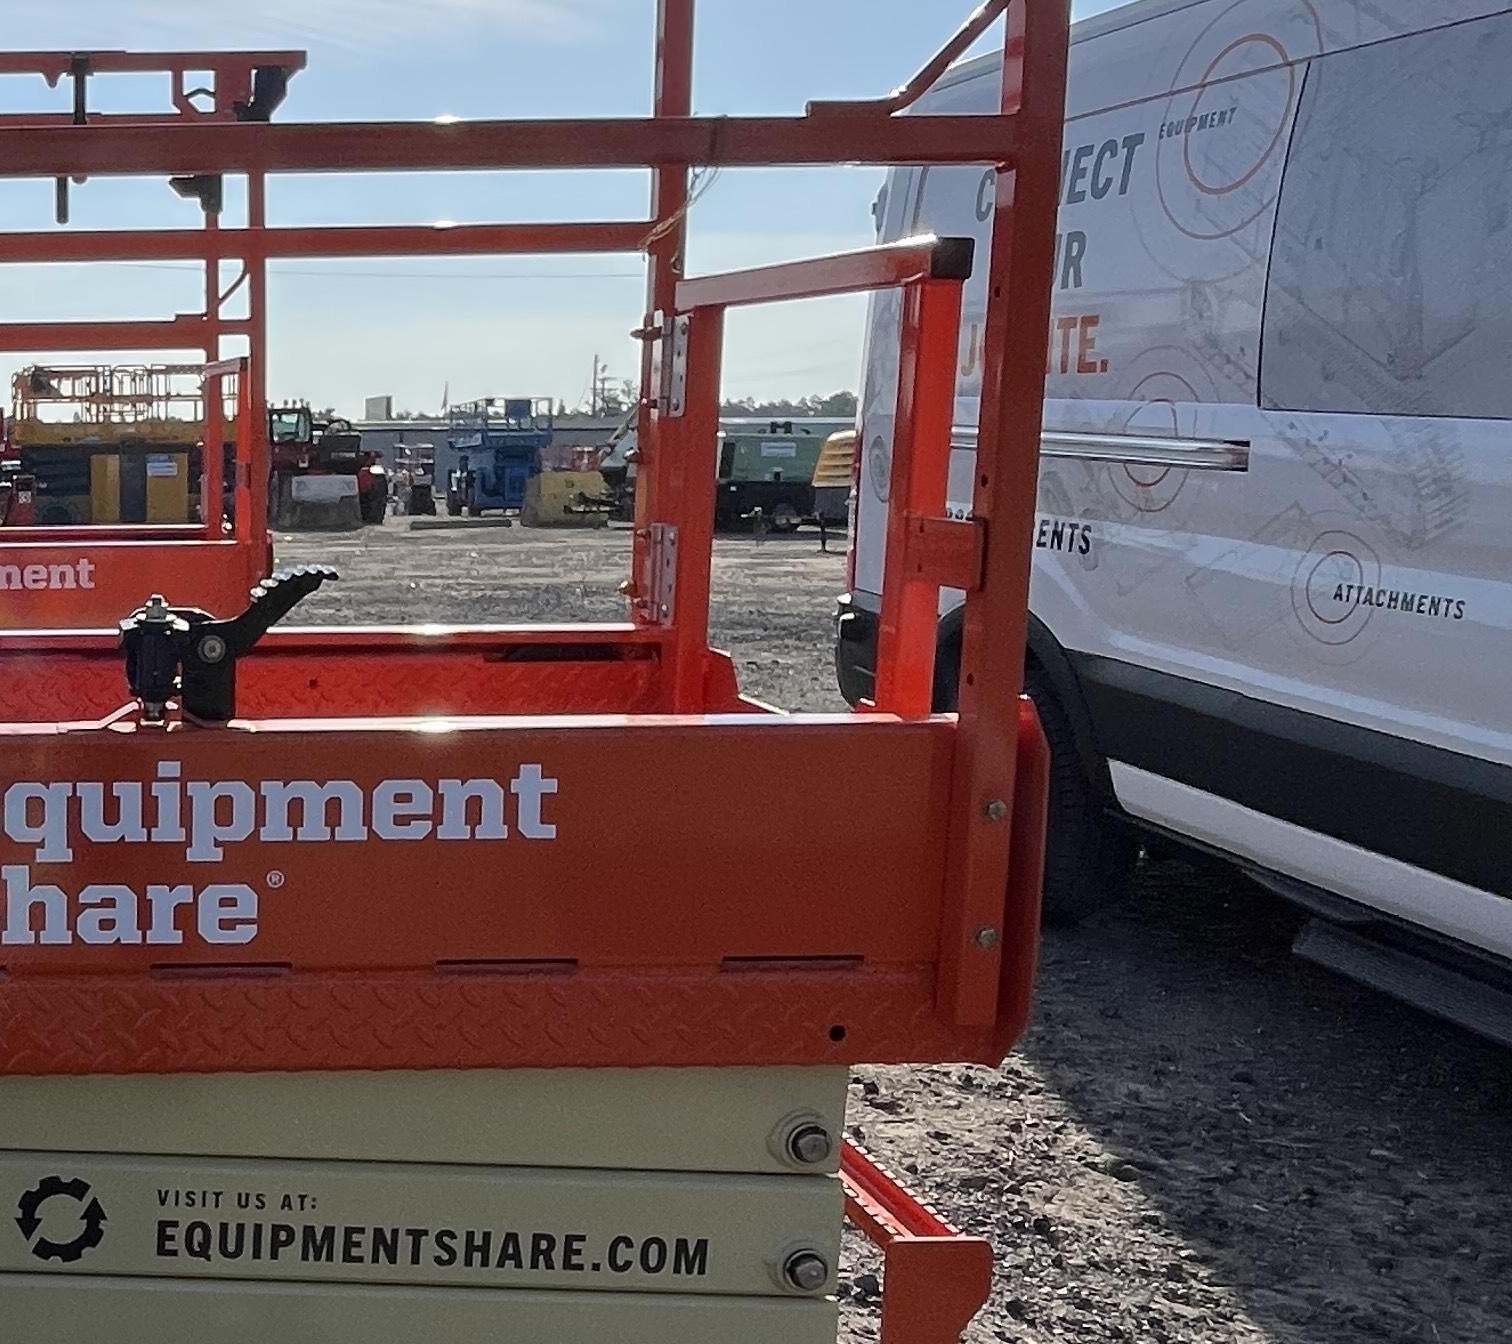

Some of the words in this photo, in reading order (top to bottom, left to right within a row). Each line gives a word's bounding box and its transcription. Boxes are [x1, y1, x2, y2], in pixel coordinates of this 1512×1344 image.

[1158, 106, 1237, 141] EQUIPMENT
[975, 133, 1144, 223] CECT
[960, 315, 1109, 377] JITE.
[1332, 583, 1466, 620] ATTACHMENTS
[157, 1188, 225, 1210] VISIT
[236, 1190, 266, 1210] US
[280, 1192, 318, 1212] AT:
[156, 1219, 710, 1277] EQUIPMENTSHARE.COM
